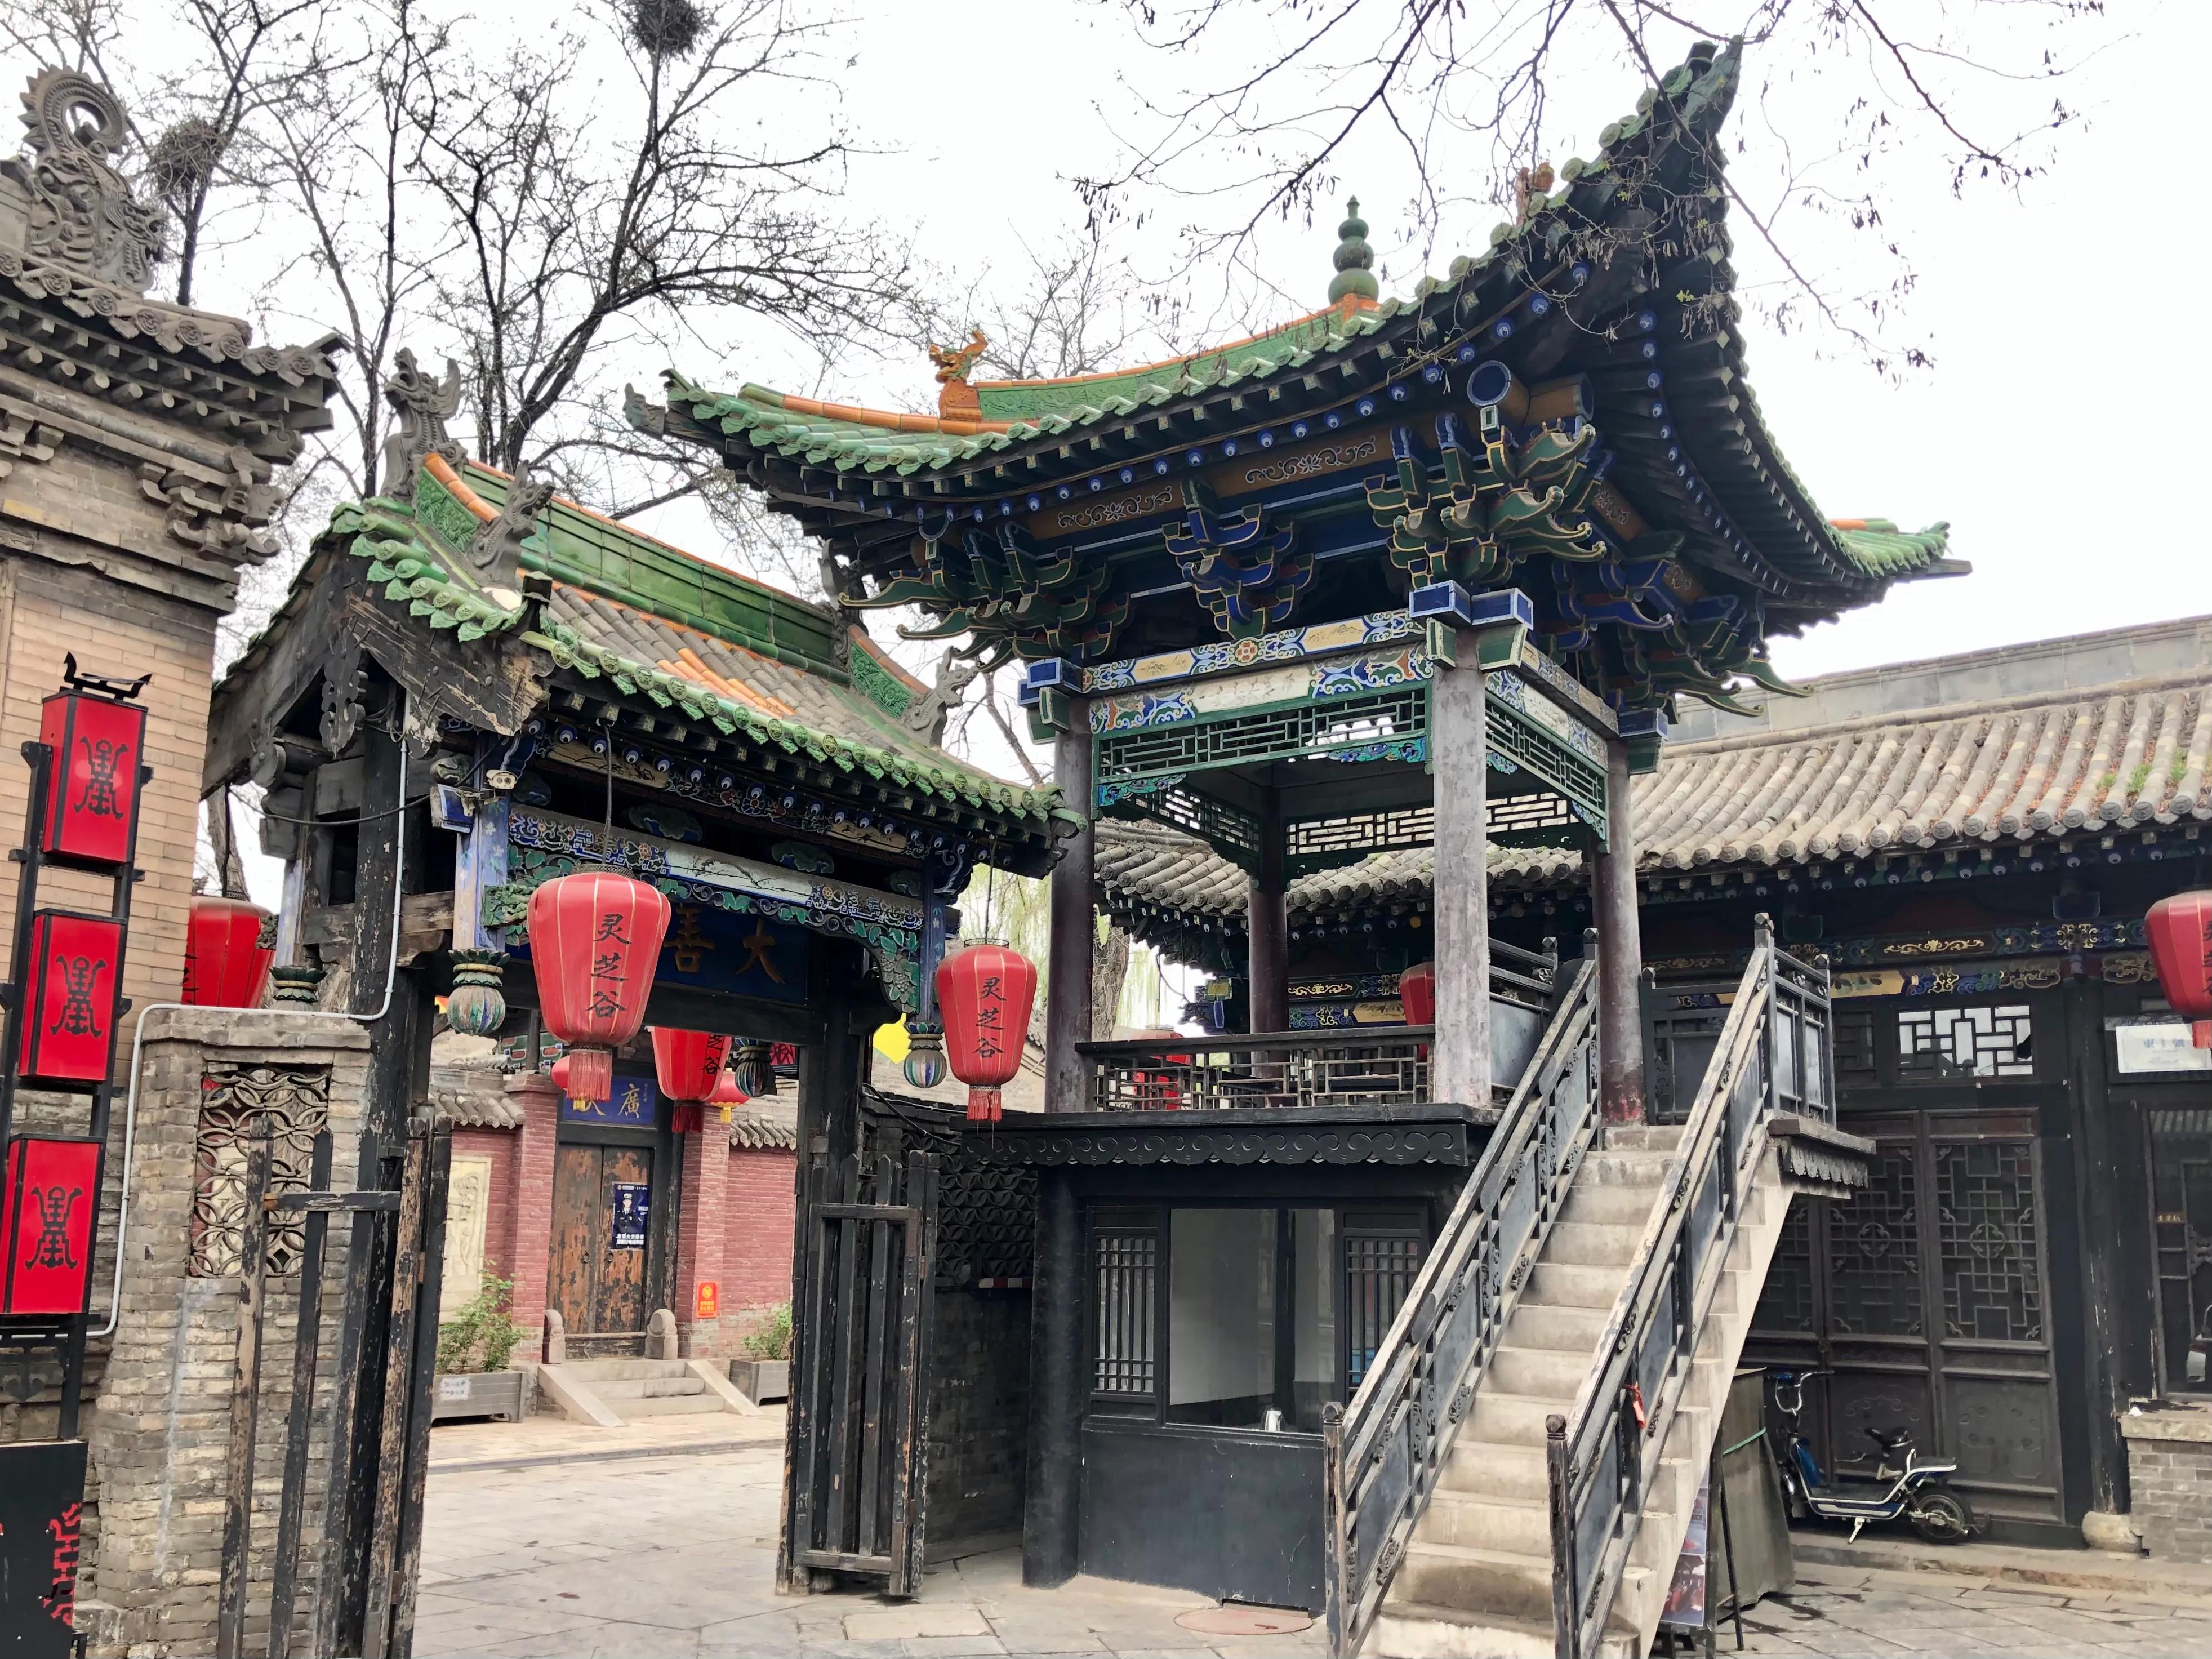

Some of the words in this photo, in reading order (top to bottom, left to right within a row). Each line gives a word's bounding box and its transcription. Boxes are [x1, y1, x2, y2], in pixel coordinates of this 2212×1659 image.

[585, 914, 632, 1018] 灵芝谷
[972, 977, 1007, 1058] 灵芝谷
